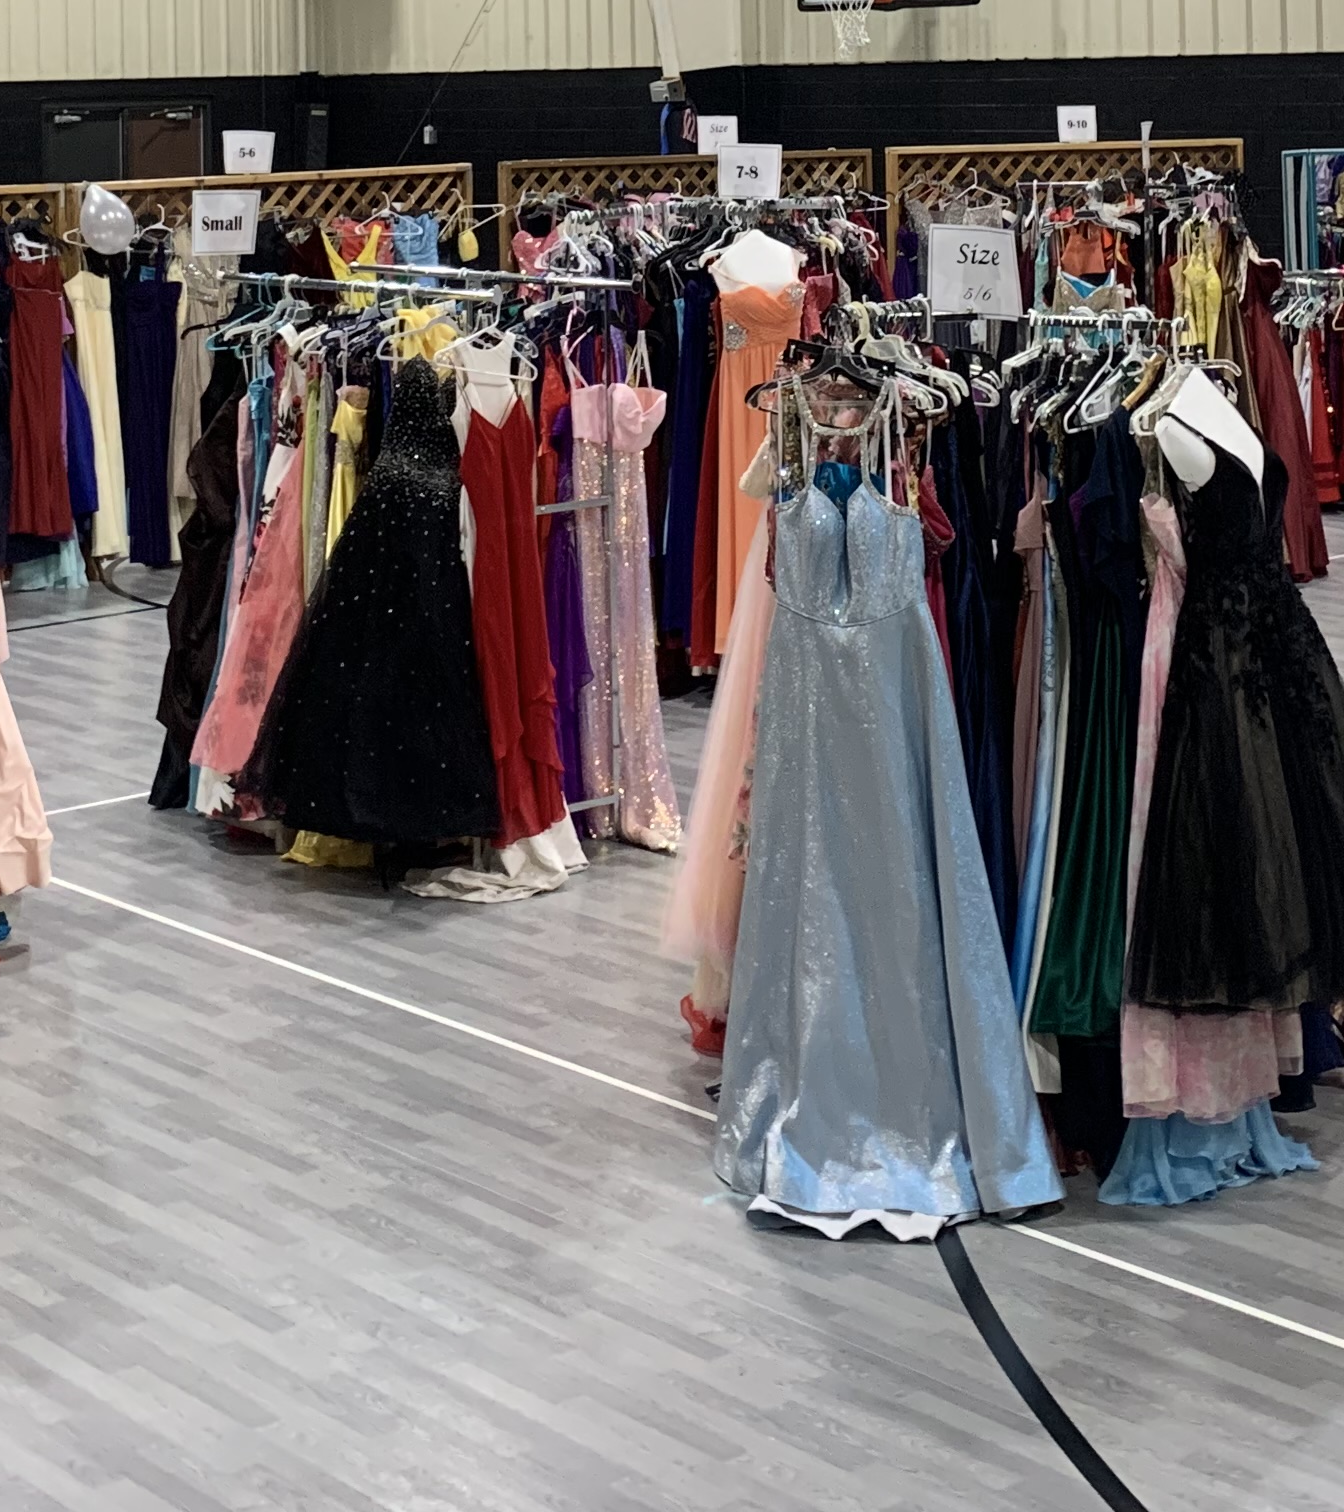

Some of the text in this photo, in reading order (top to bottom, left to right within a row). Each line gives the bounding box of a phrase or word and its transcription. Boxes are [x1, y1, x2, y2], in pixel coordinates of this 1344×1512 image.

[709, 122, 729, 134] Size
[1067, 120, 1088, 129] 9-10
[238, 147, 256, 158] 5-6
[736, 165, 759, 179] 7-8
[201, 215, 243, 232] Small
[956, 242, 1001, 266] Size
[962, 284, 993, 301] 5/6
